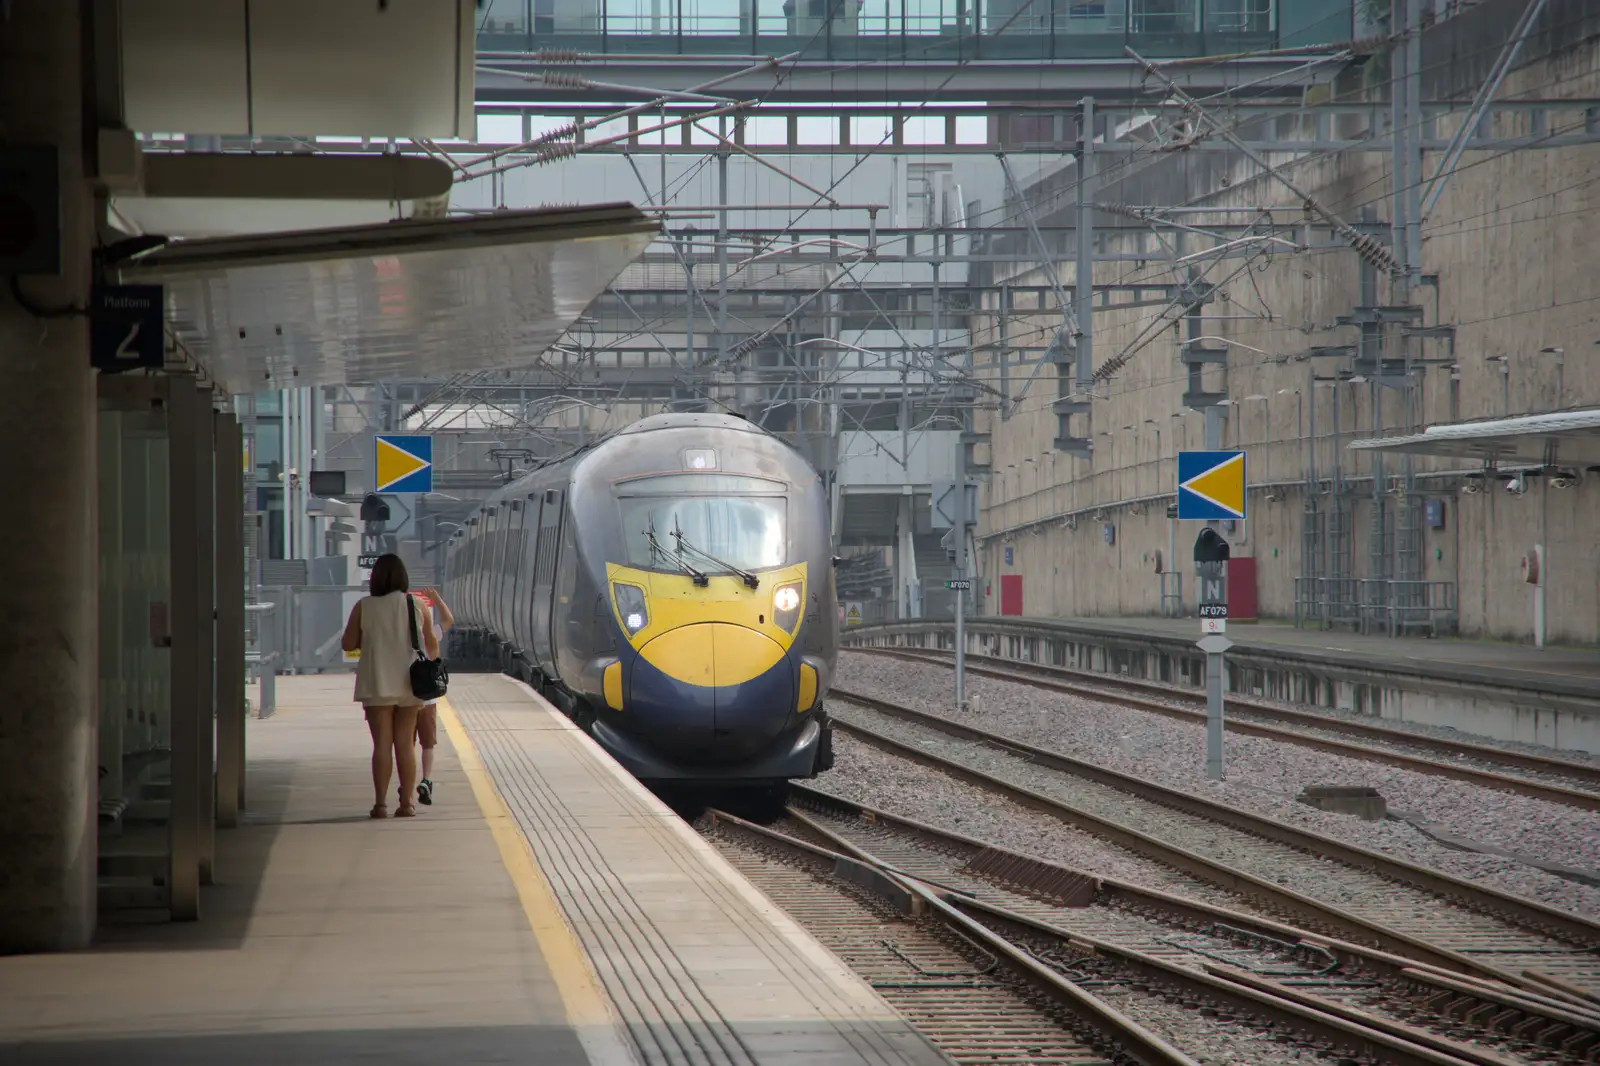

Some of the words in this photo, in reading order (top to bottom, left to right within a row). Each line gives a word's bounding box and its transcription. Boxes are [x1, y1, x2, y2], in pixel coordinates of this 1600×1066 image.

[104, 294, 151, 308] Platform
[114, 320, 141, 359] 2
[365, 535, 377, 552] N
[360, 557, 379, 565] AF07
[950, 581, 970, 589] AF070
[1207, 580, 1220, 600] N
[1200, 606, 1228, 616] AF079
